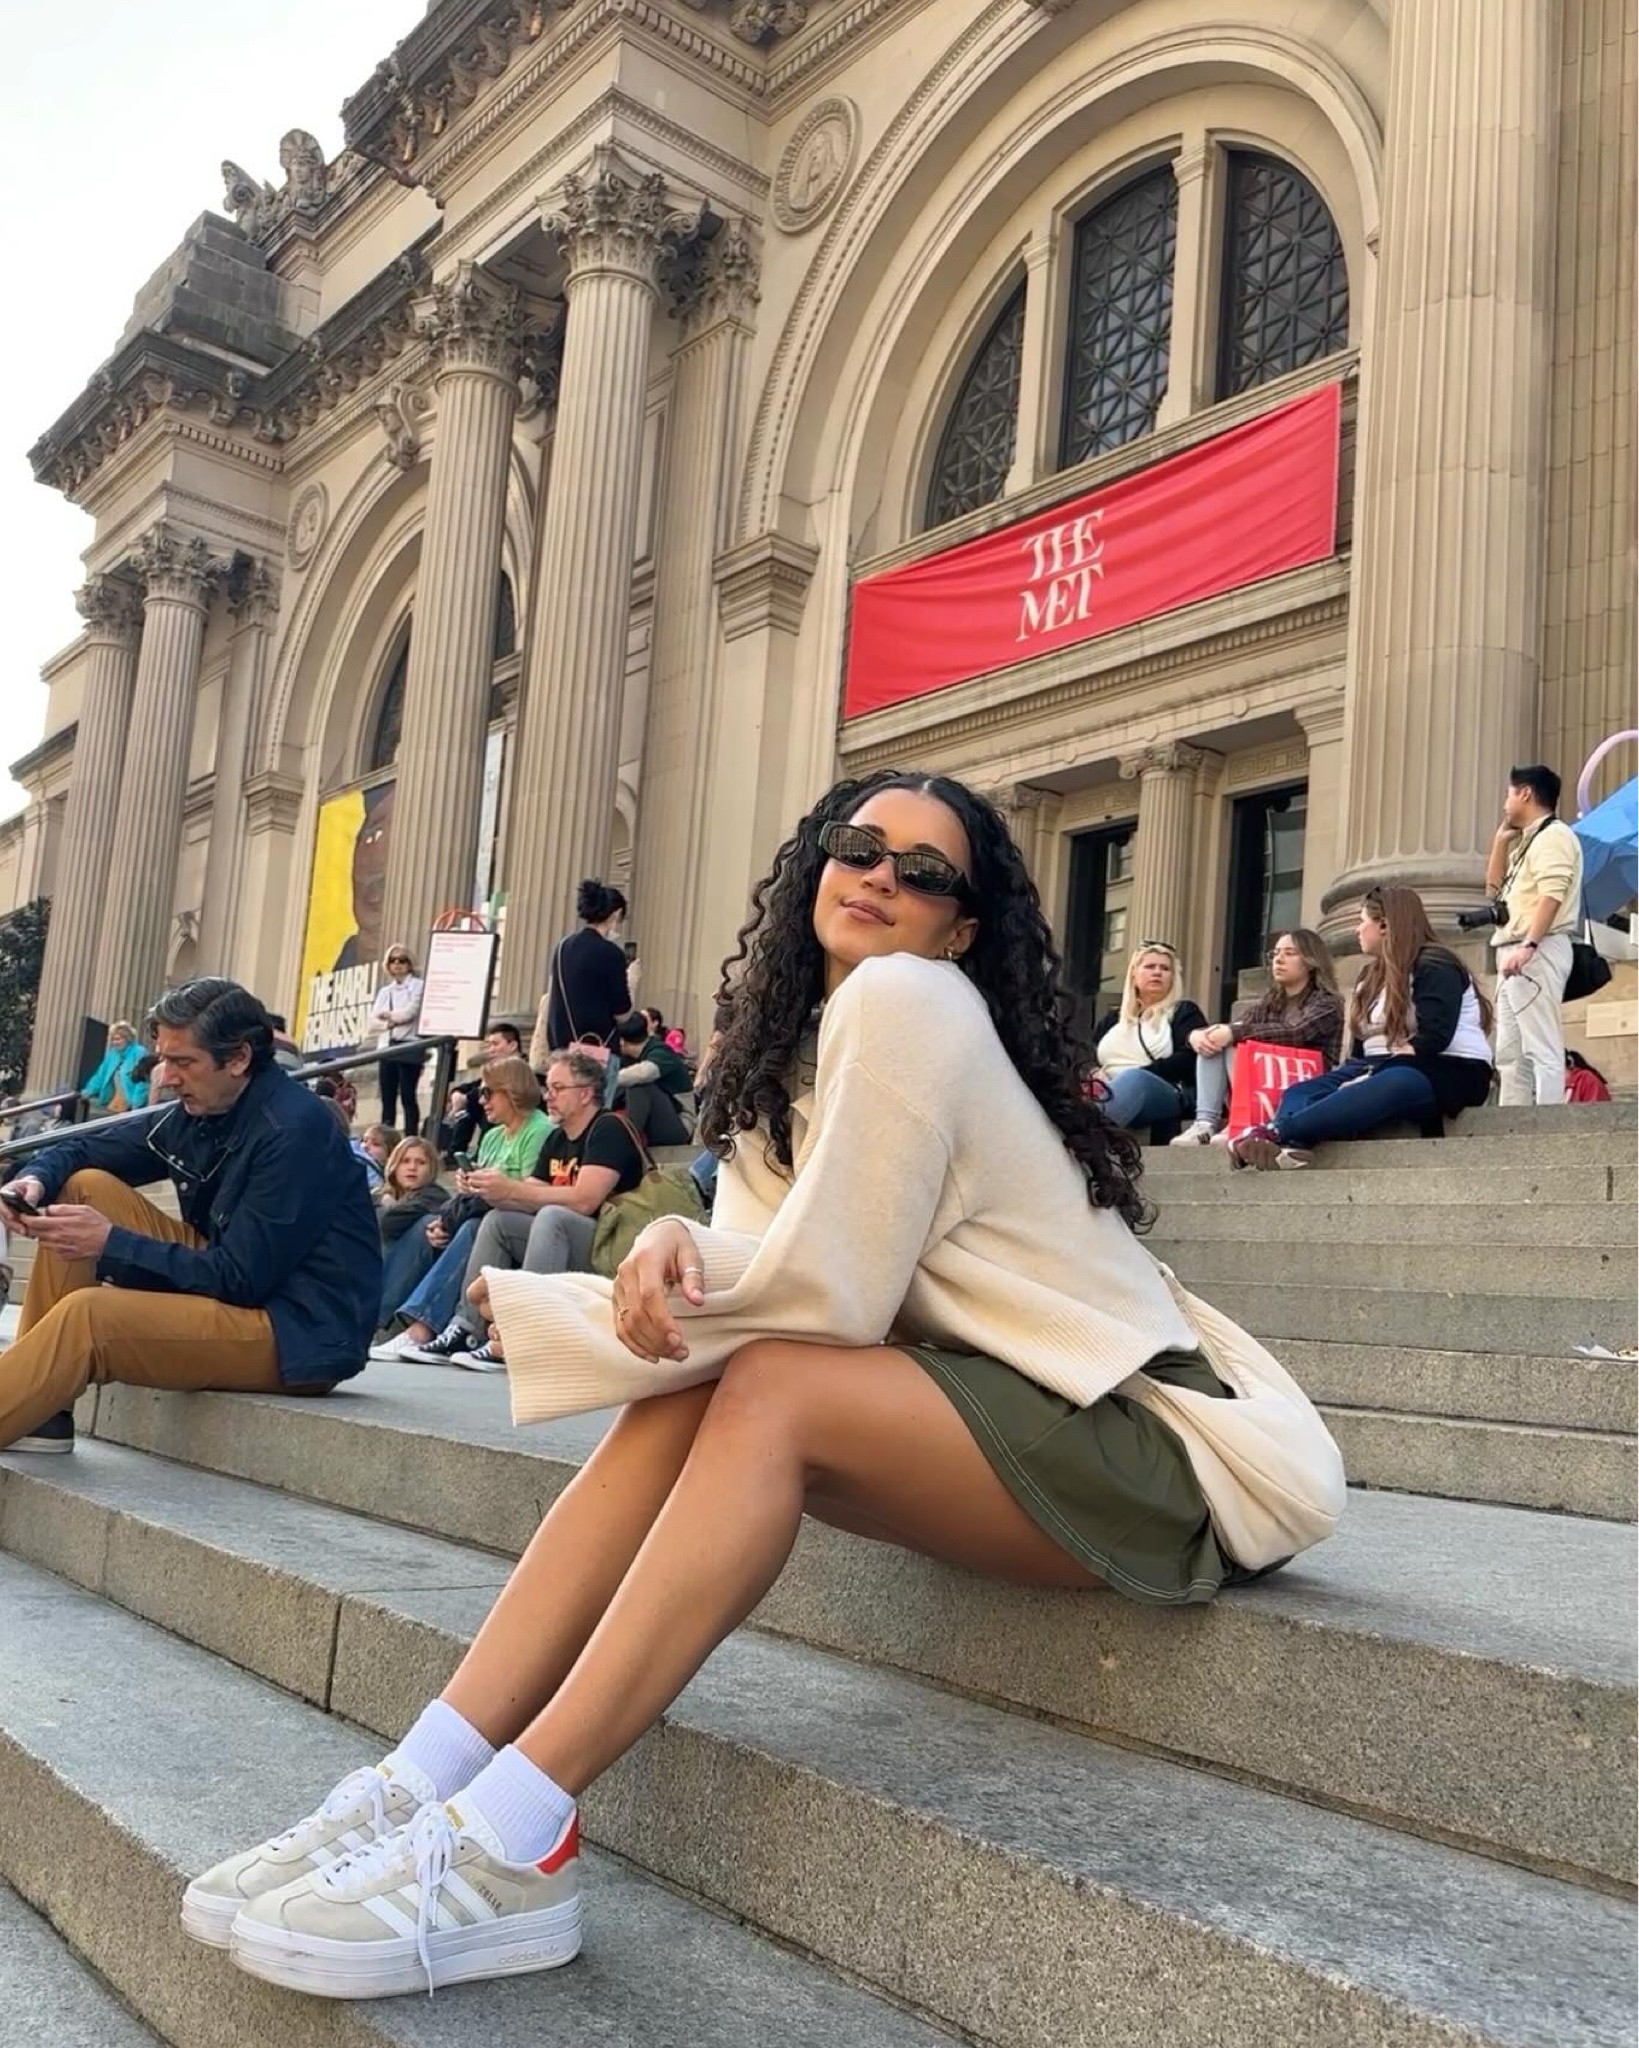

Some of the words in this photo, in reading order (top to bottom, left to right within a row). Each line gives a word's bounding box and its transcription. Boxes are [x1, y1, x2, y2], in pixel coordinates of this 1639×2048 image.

[1021, 509, 1104, 582] THE
[1015, 562, 1104, 643] MET
[306, 972, 333, 1015] THE
[331, 960, 379, 1010] HARL
[1253, 1051, 1317, 1090] THE
